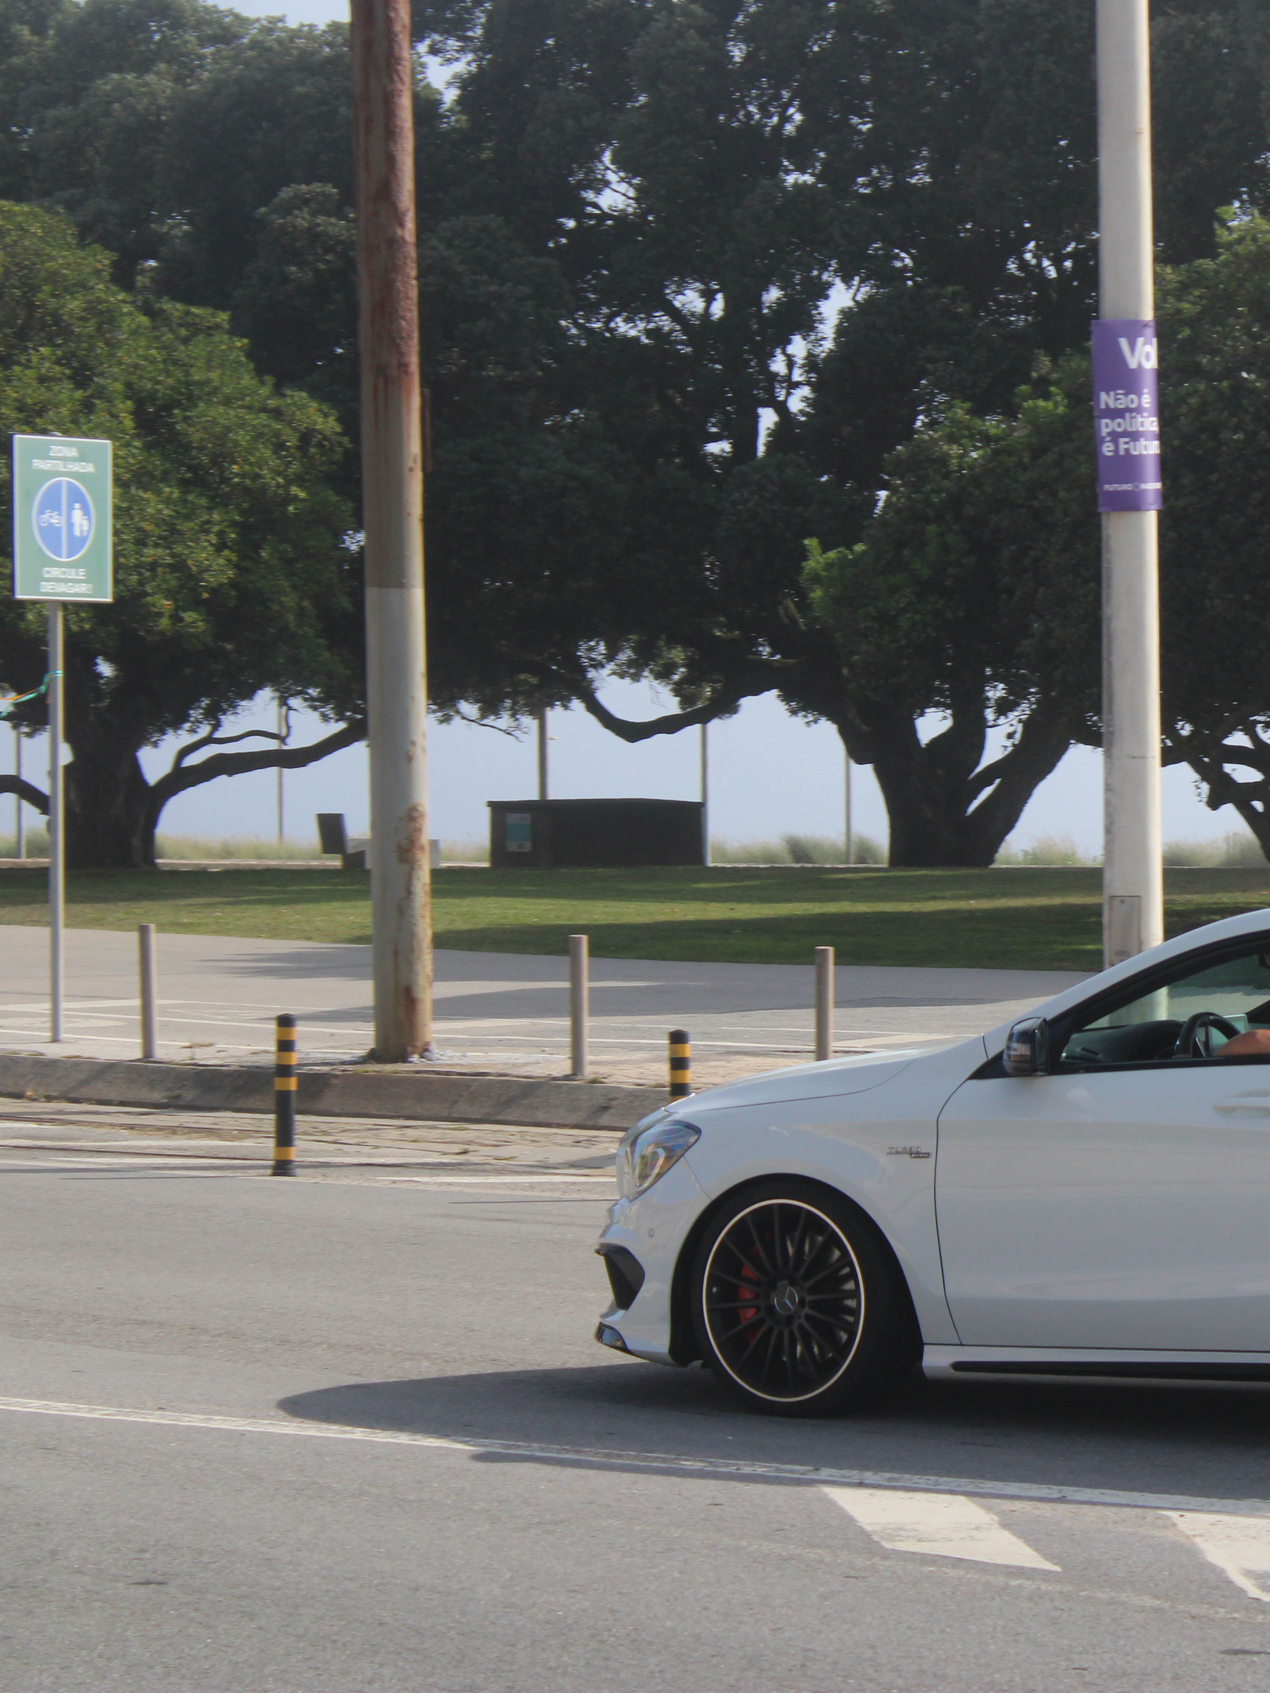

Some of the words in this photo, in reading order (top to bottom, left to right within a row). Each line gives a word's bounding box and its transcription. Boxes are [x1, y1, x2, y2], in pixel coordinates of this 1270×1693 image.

[1100, 389, 1138, 409] Não
[1141, 388, 1151, 408] é
[49, 445, 79, 457] ZONA
[1102, 436, 1115, 456] é
[31, 458, 95, 473] PARTILHADA
[42, 567, 86, 579] CIRCULE
